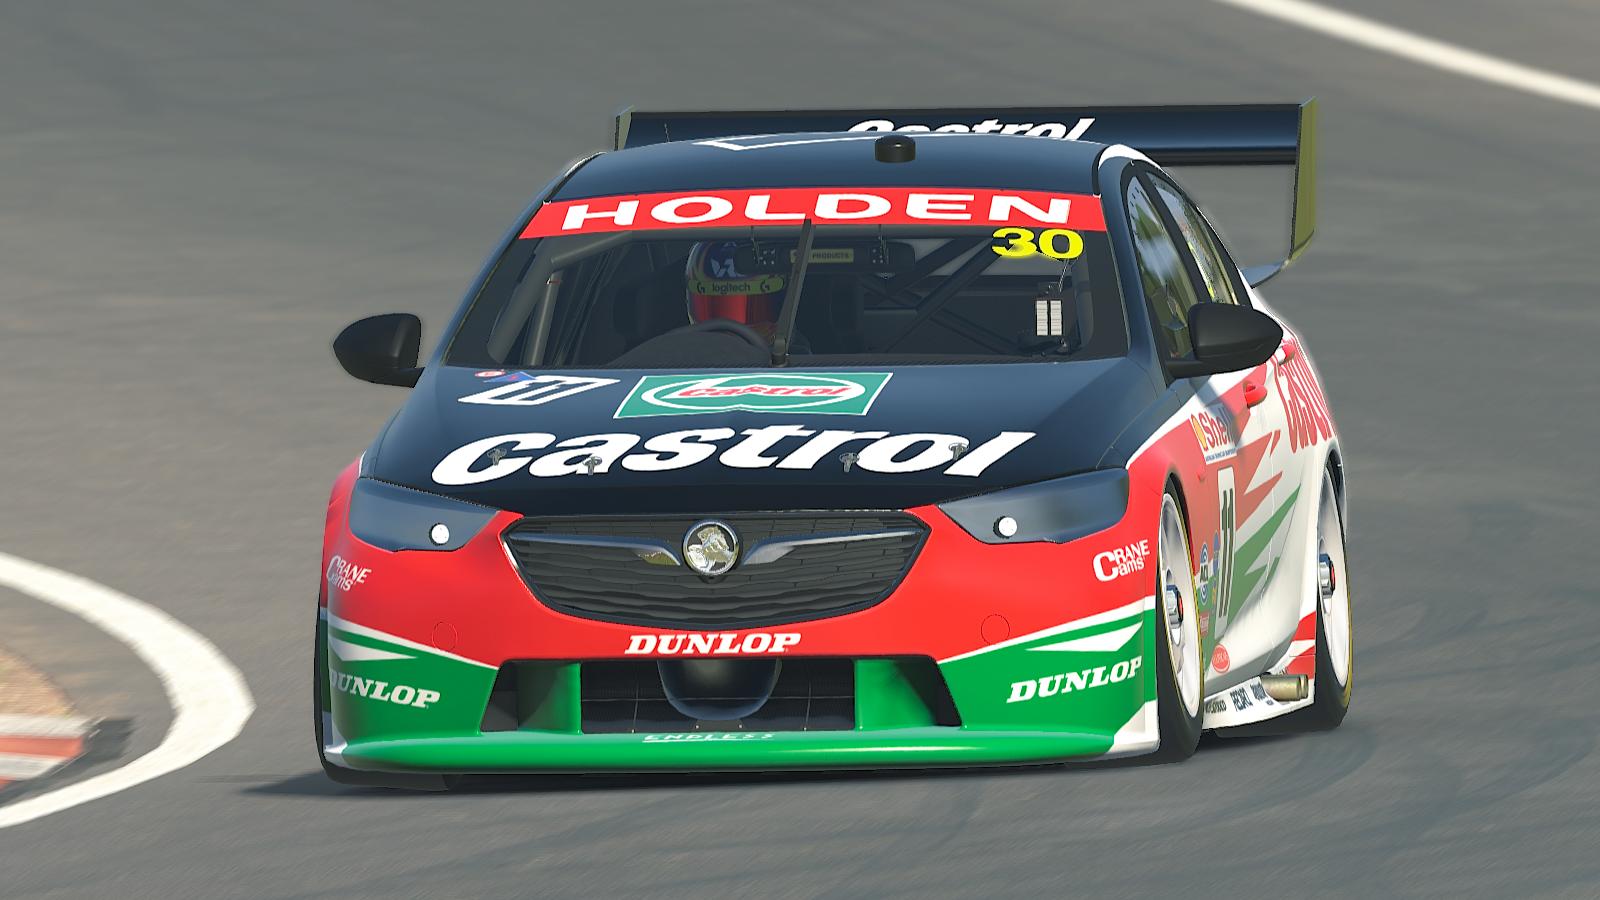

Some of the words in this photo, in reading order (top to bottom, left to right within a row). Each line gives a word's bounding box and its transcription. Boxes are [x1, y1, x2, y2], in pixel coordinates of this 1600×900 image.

[561, 192, 1072, 230] HOLDEN
[991, 227, 1084, 260] 30
[712, 283, 751, 294] logitech
[677, 386, 852, 397] Castrol
[1198, 406, 1236, 449] Shell
[431, 424, 1036, 486] Castrol
[327, 555, 372, 584] CRANE
[1093, 540, 1150, 582] CRANE
[1219, 487, 1235, 618] 11
[624, 632, 801, 655] DUNLOP
[330, 669, 440, 708] DUNLOP
[1006, 656, 1143, 704] DUNLOP
[643, 733, 776, 742] ENDLESS
